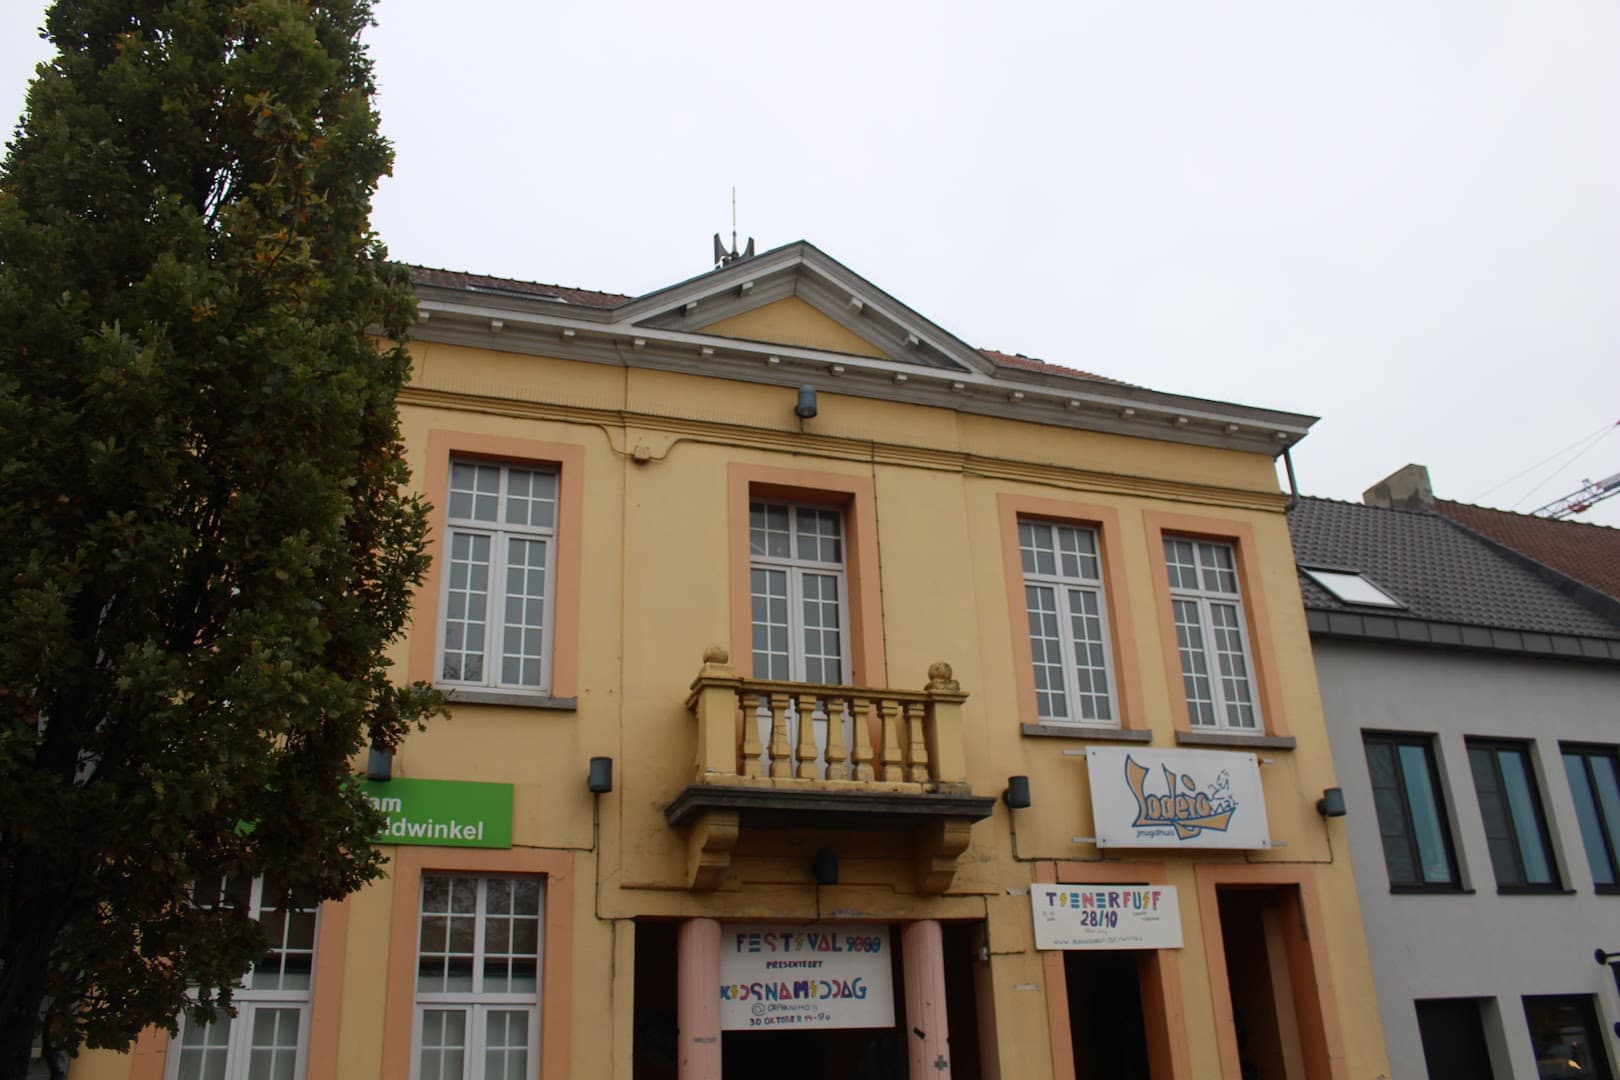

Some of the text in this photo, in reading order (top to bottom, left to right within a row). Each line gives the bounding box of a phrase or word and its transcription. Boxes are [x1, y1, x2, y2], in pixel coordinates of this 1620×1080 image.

[376, 817, 484, 841] ldwinkel
[1045, 891, 1162, 911] TIENERFUIF
[1080, 910, 1118, 928] 28/10
[736, 932, 843, 952] FESTIVAL
